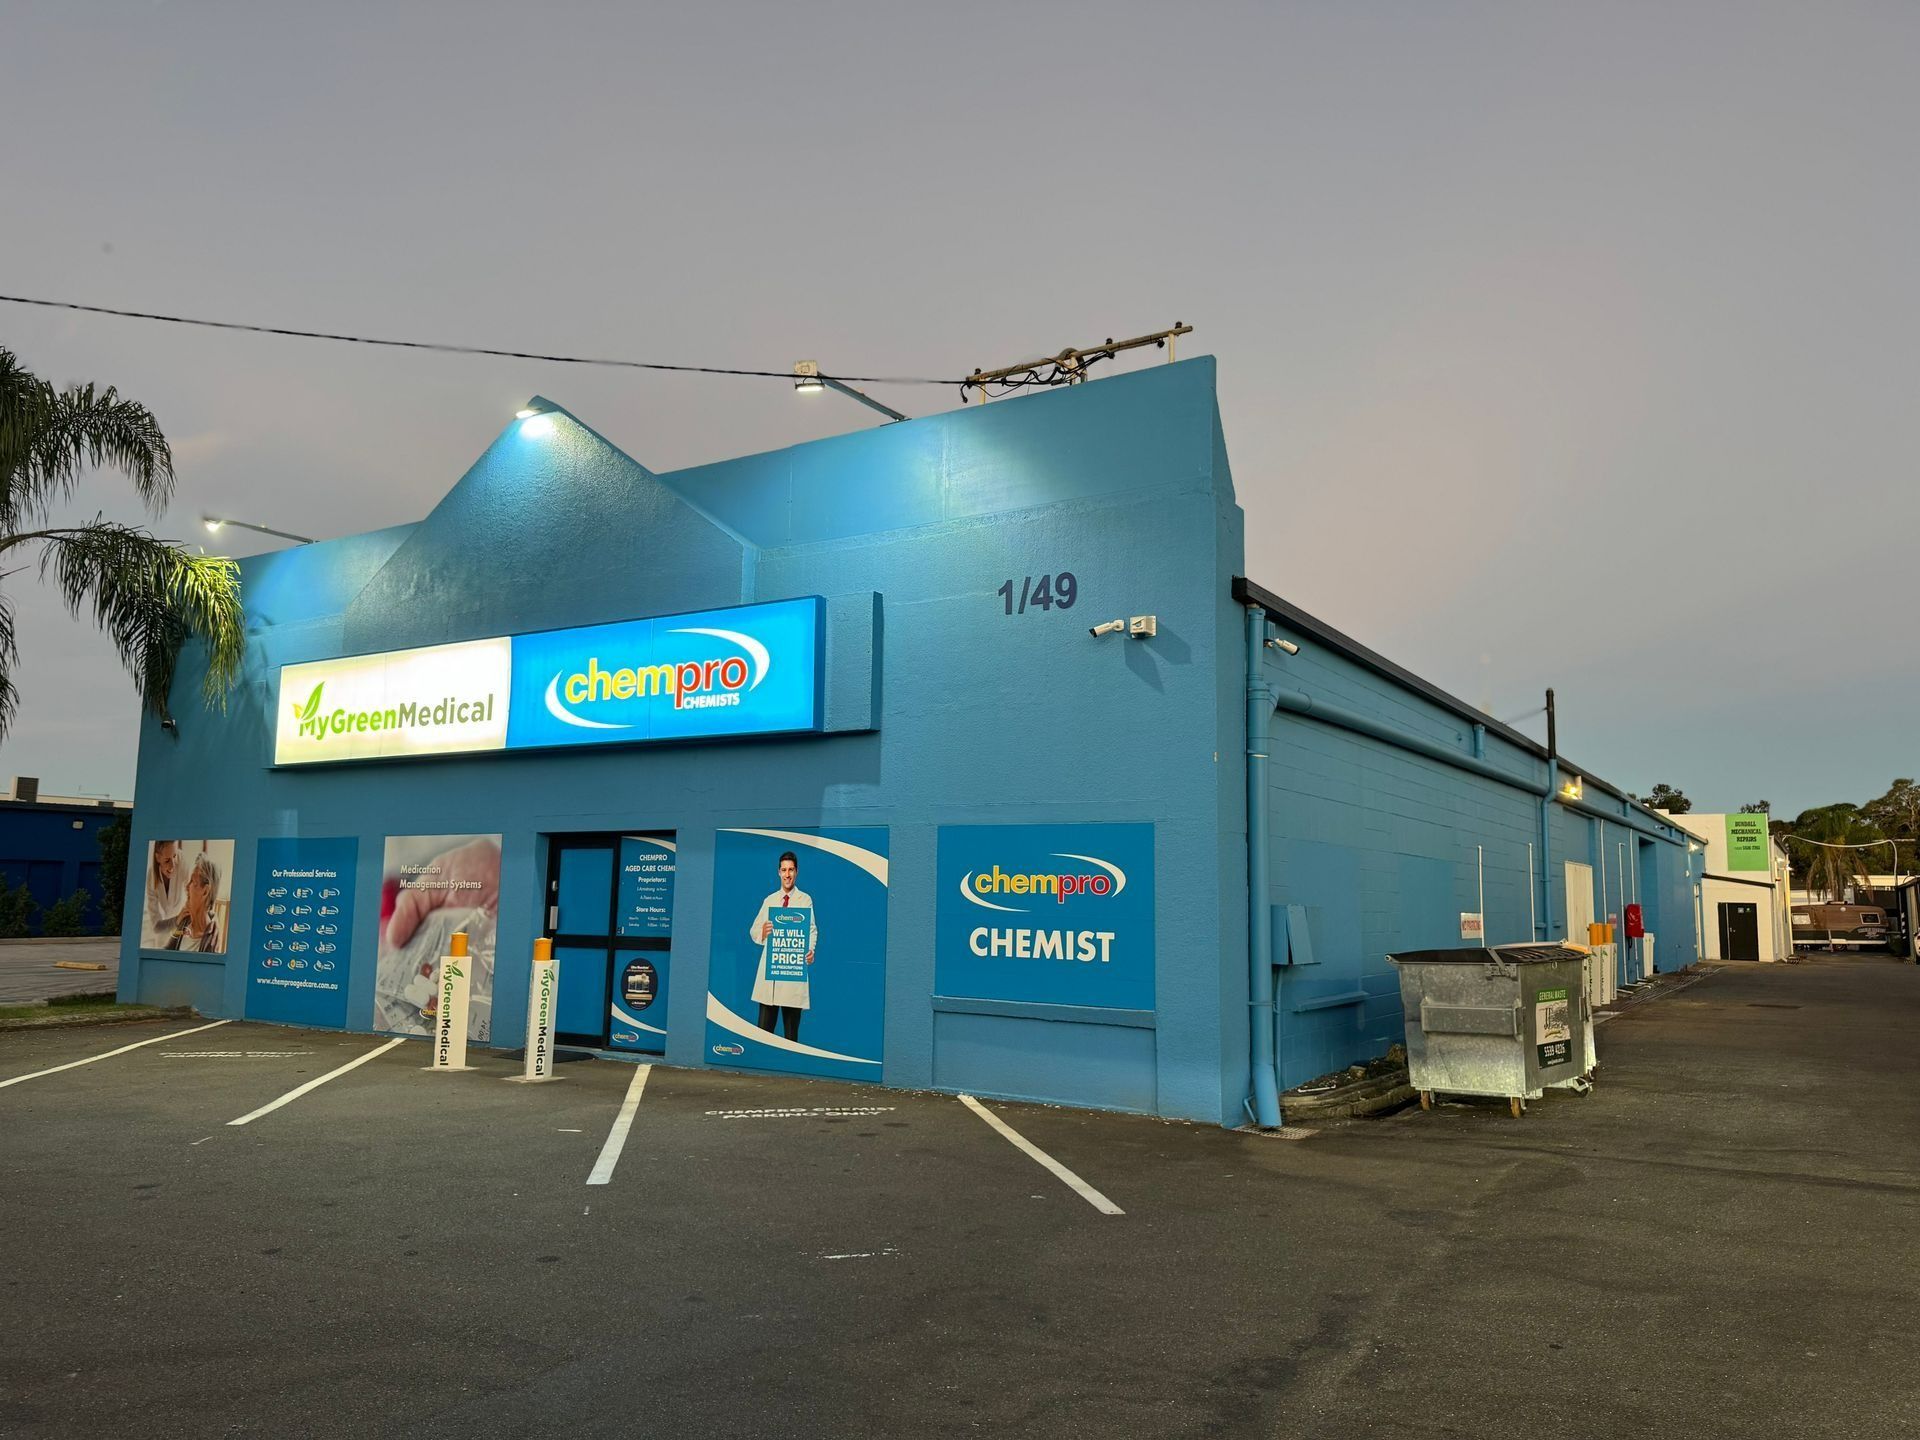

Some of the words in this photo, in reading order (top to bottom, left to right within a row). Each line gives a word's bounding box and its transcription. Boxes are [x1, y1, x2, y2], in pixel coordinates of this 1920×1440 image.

[998, 571, 1078, 615] 1/49
[564, 656, 748, 710] chempro
[683, 691, 740, 710] CHEMISTS
[298, 693, 493, 740] MyGreenMedical
[272, 869, 283, 878] Our
[283, 868, 315, 878] Professional
[315, 869, 337, 878] Services
[400, 864, 441, 874] Medication
[625, 864, 641, 872] AGED
[641, 864, 657, 872] CARE
[399, 879, 450, 891] Management
[450, 879, 482, 891] Systems
[638, 876, 667, 884] Proprietors:
[974, 865, 1111, 904] chempro
[772, 929, 785, 937] WE
[786, 929, 805, 938] WILL
[772, 938, 805, 948] MATCH
[969, 926, 1115, 962] CHEMIST
[771, 953, 804, 964] PRICE
[256, 977, 339, 990] www.chemproagedcare.com.au
[1539, 991, 1555, 1001] GENERAL
[1554, 989, 1566, 999] WASTE
[440, 965, 453, 1066] MyGreenMedical
[535, 969, 551, 1076] MyGreenMedical
[722, 1111, 819, 1119] PARKING
